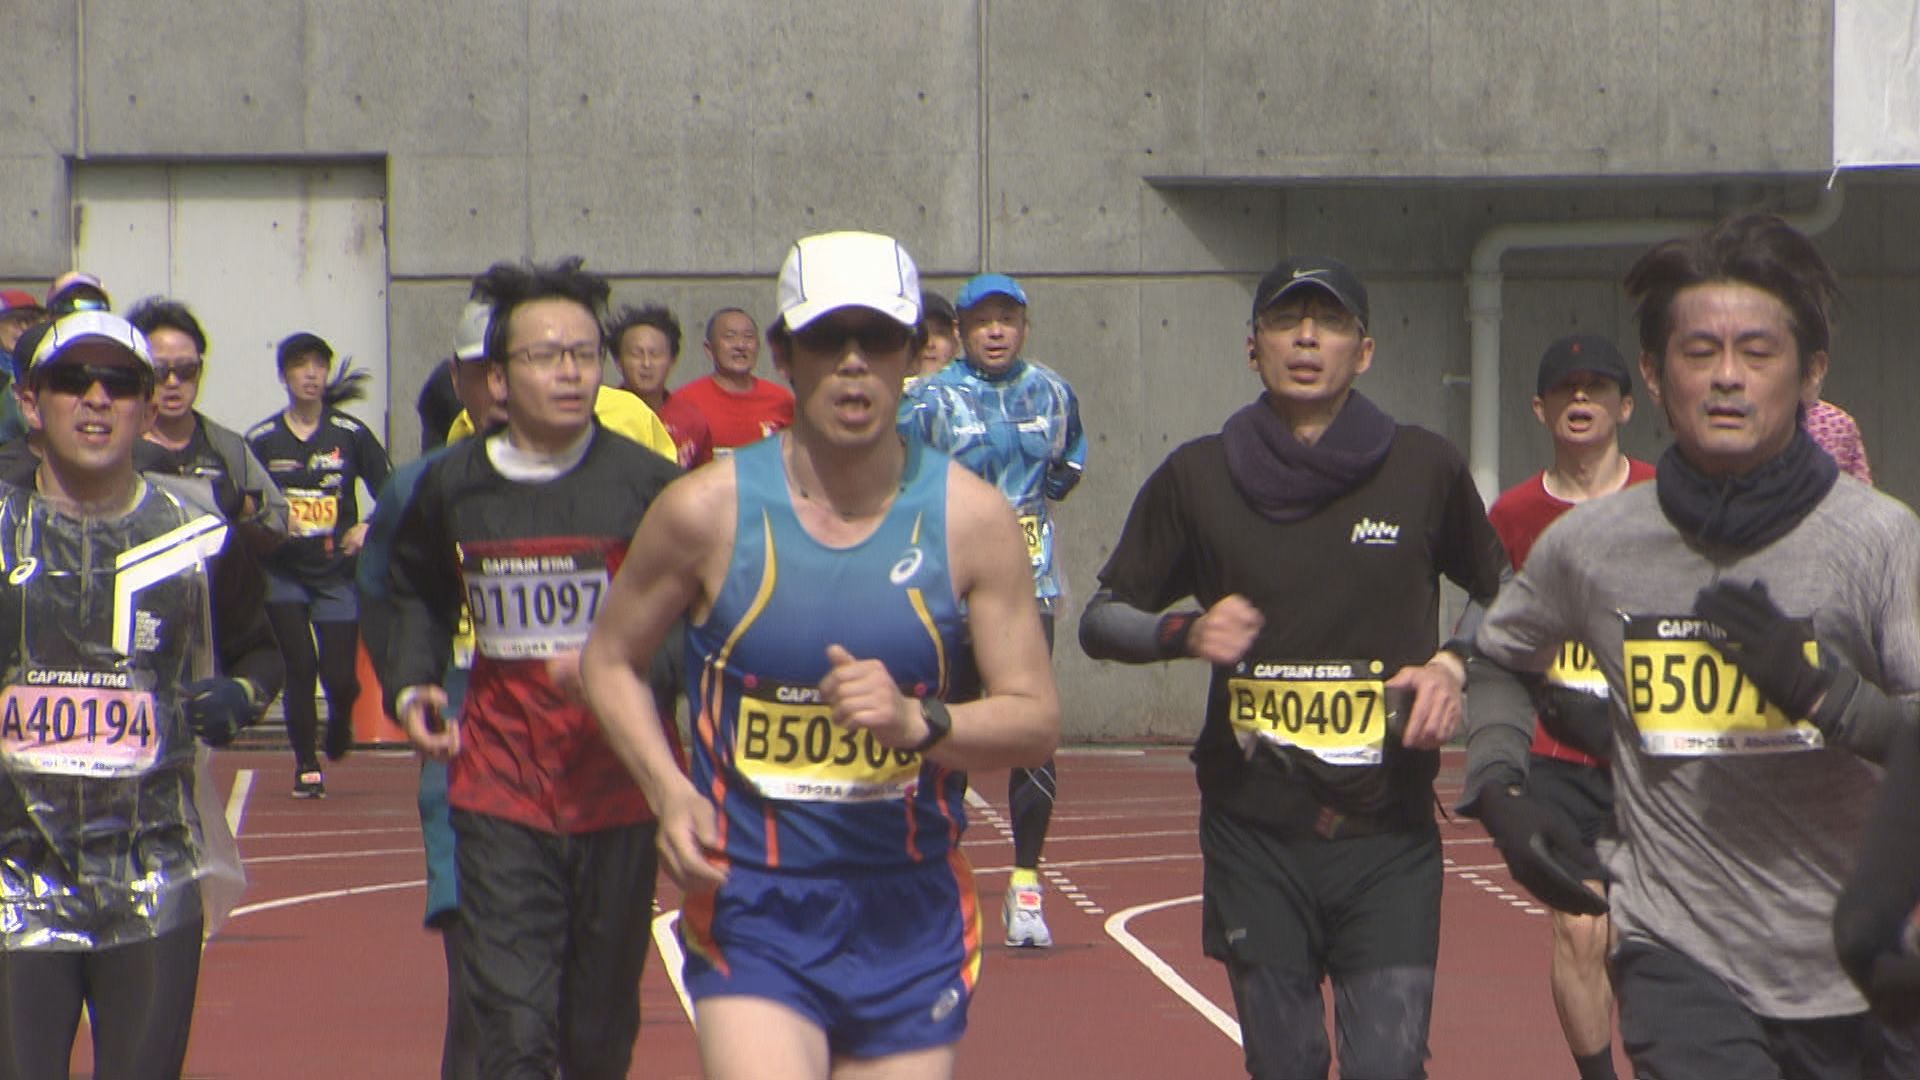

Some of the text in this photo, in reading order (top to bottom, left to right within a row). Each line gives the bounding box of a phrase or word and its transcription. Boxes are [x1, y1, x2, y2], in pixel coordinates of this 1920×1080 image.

[482, 557, 539, 576] CAPTAIN
[468, 580, 602, 628] D11097
[27, 670, 127, 687] CAPTAIN STAG
[1254, 664, 1353, 679] CAPTAIN STAG
[1631, 654, 1766, 714] B507
[2, 695, 151, 748] A40194
[1236, 687, 1377, 735] B40407
